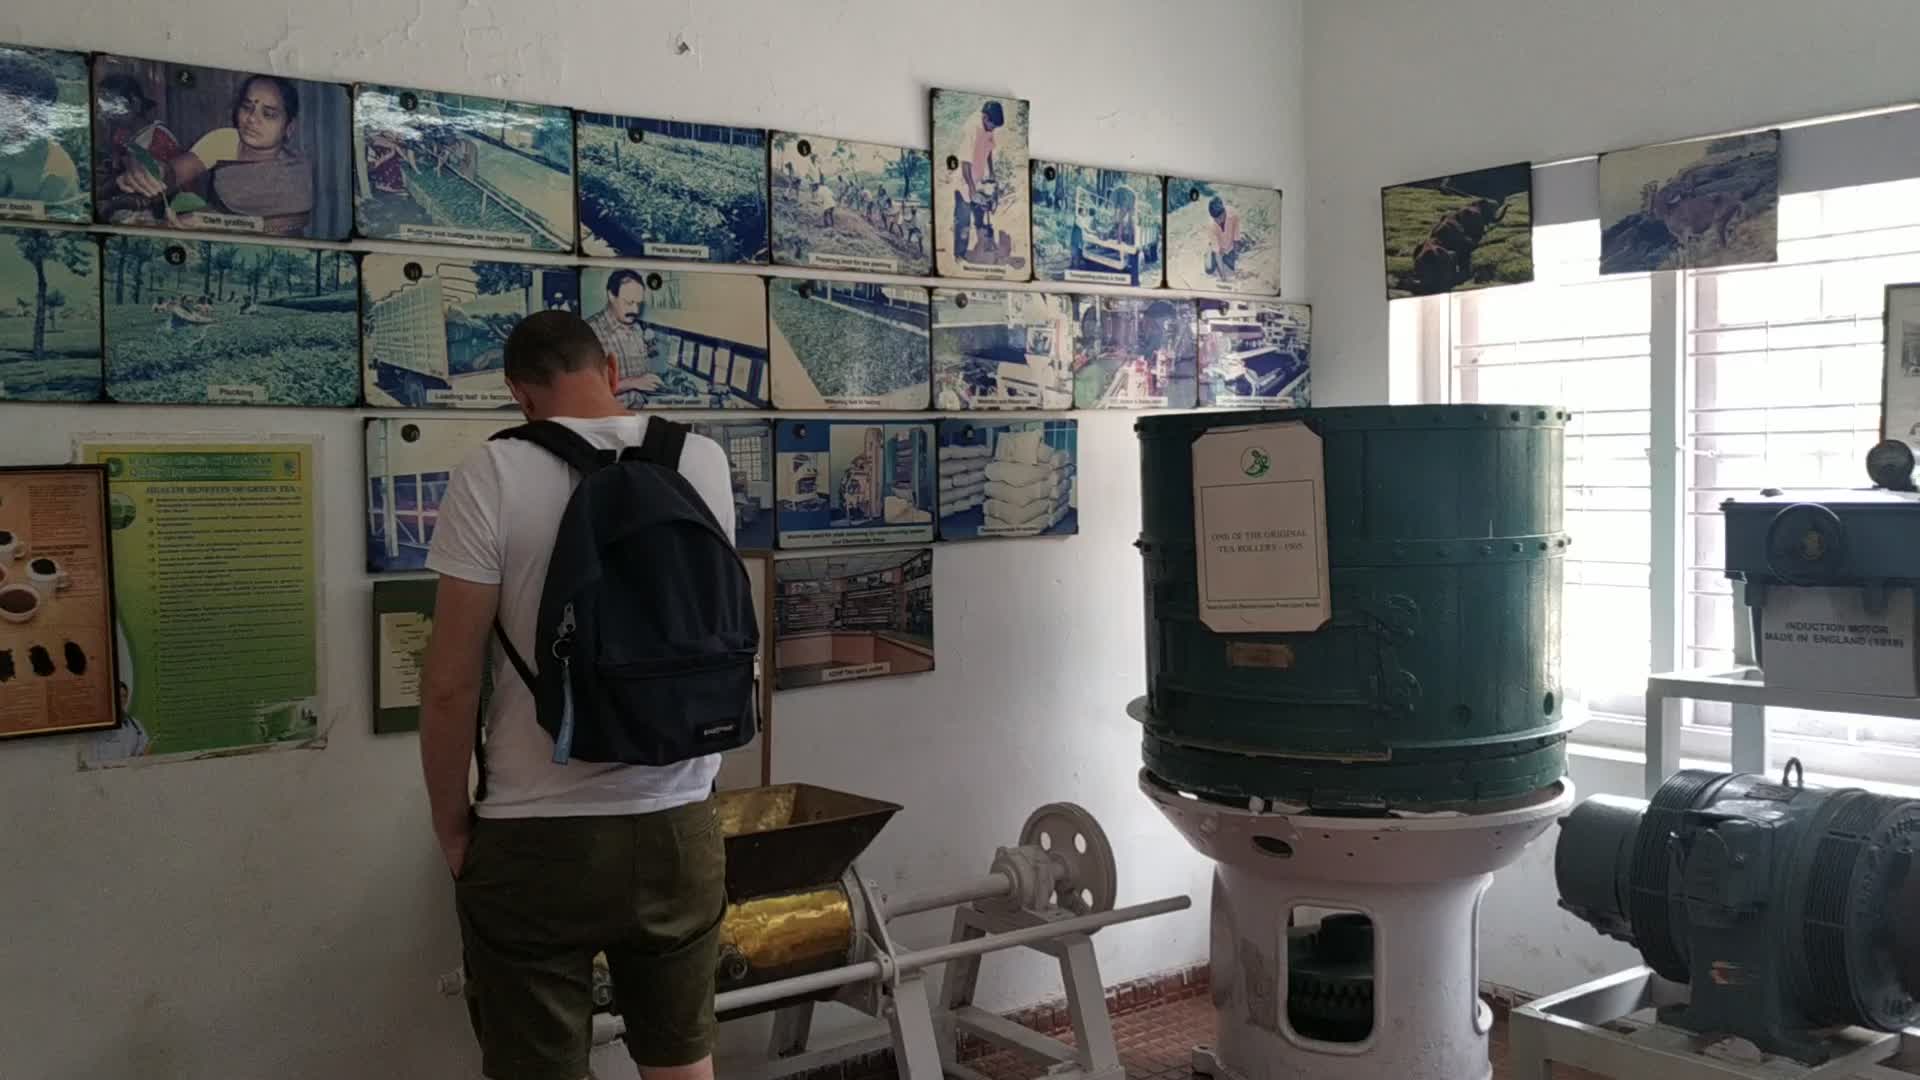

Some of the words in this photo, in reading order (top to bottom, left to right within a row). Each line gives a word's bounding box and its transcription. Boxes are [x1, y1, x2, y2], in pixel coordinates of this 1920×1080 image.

[1210, 532, 1230, 541] ONE
[1232, 531, 1242, 540] OF
[1245, 530, 1262, 539] THE
[1263, 528, 1307, 538] ORIGINAL
[1217, 544, 1235, 553] TEA
[1237, 543, 1276, 553] ROLLERS
[1785, 621, 1844, 633] INDUCTION
[1847, 624, 1889, 635] MOTOR
[1764, 631, 1794, 642] MADE
[1797, 632, 1809, 642] IN
[1812, 634, 1865, 646] ENGLAND
